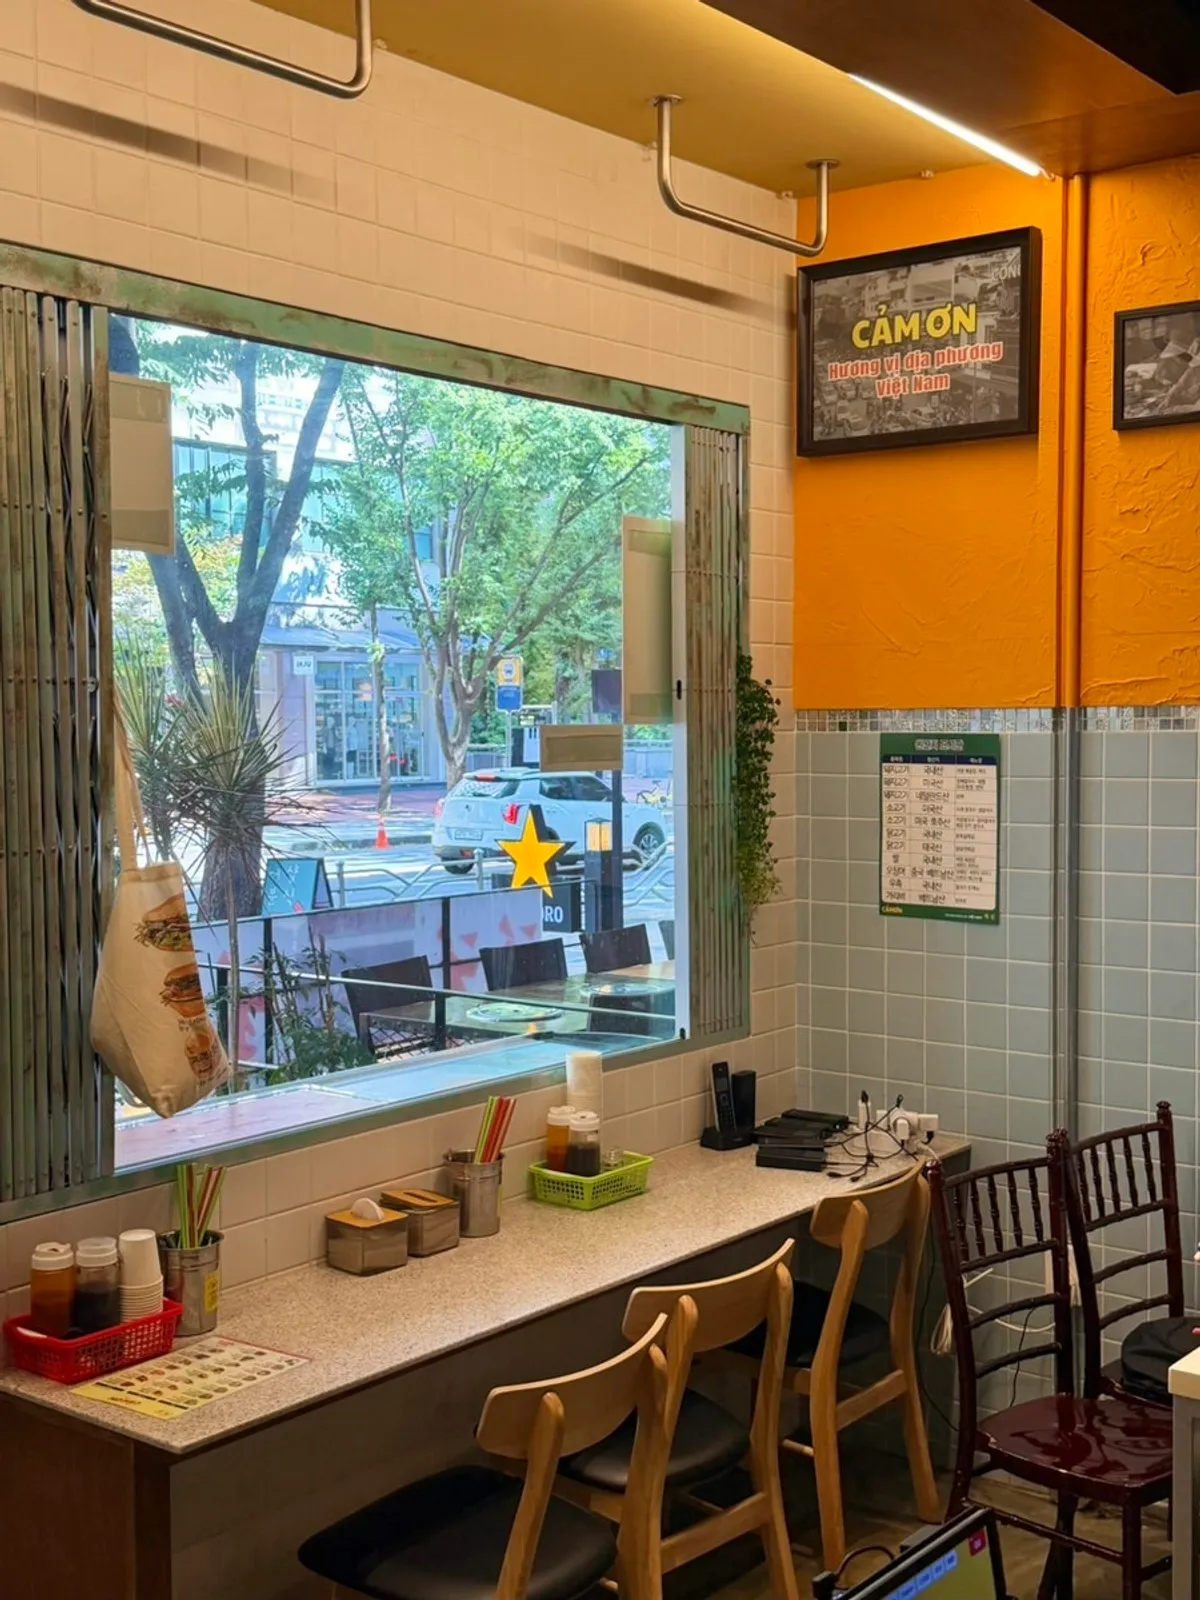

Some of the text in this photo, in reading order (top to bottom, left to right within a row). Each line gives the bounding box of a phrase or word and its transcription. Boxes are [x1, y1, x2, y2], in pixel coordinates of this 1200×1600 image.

[852, 302, 976, 349] CẢM ƠN
[828, 341, 1003, 380] Hương vị địa phương
[876, 373, 950, 399] Việt Nam
[542, 905, 563, 923] RO
